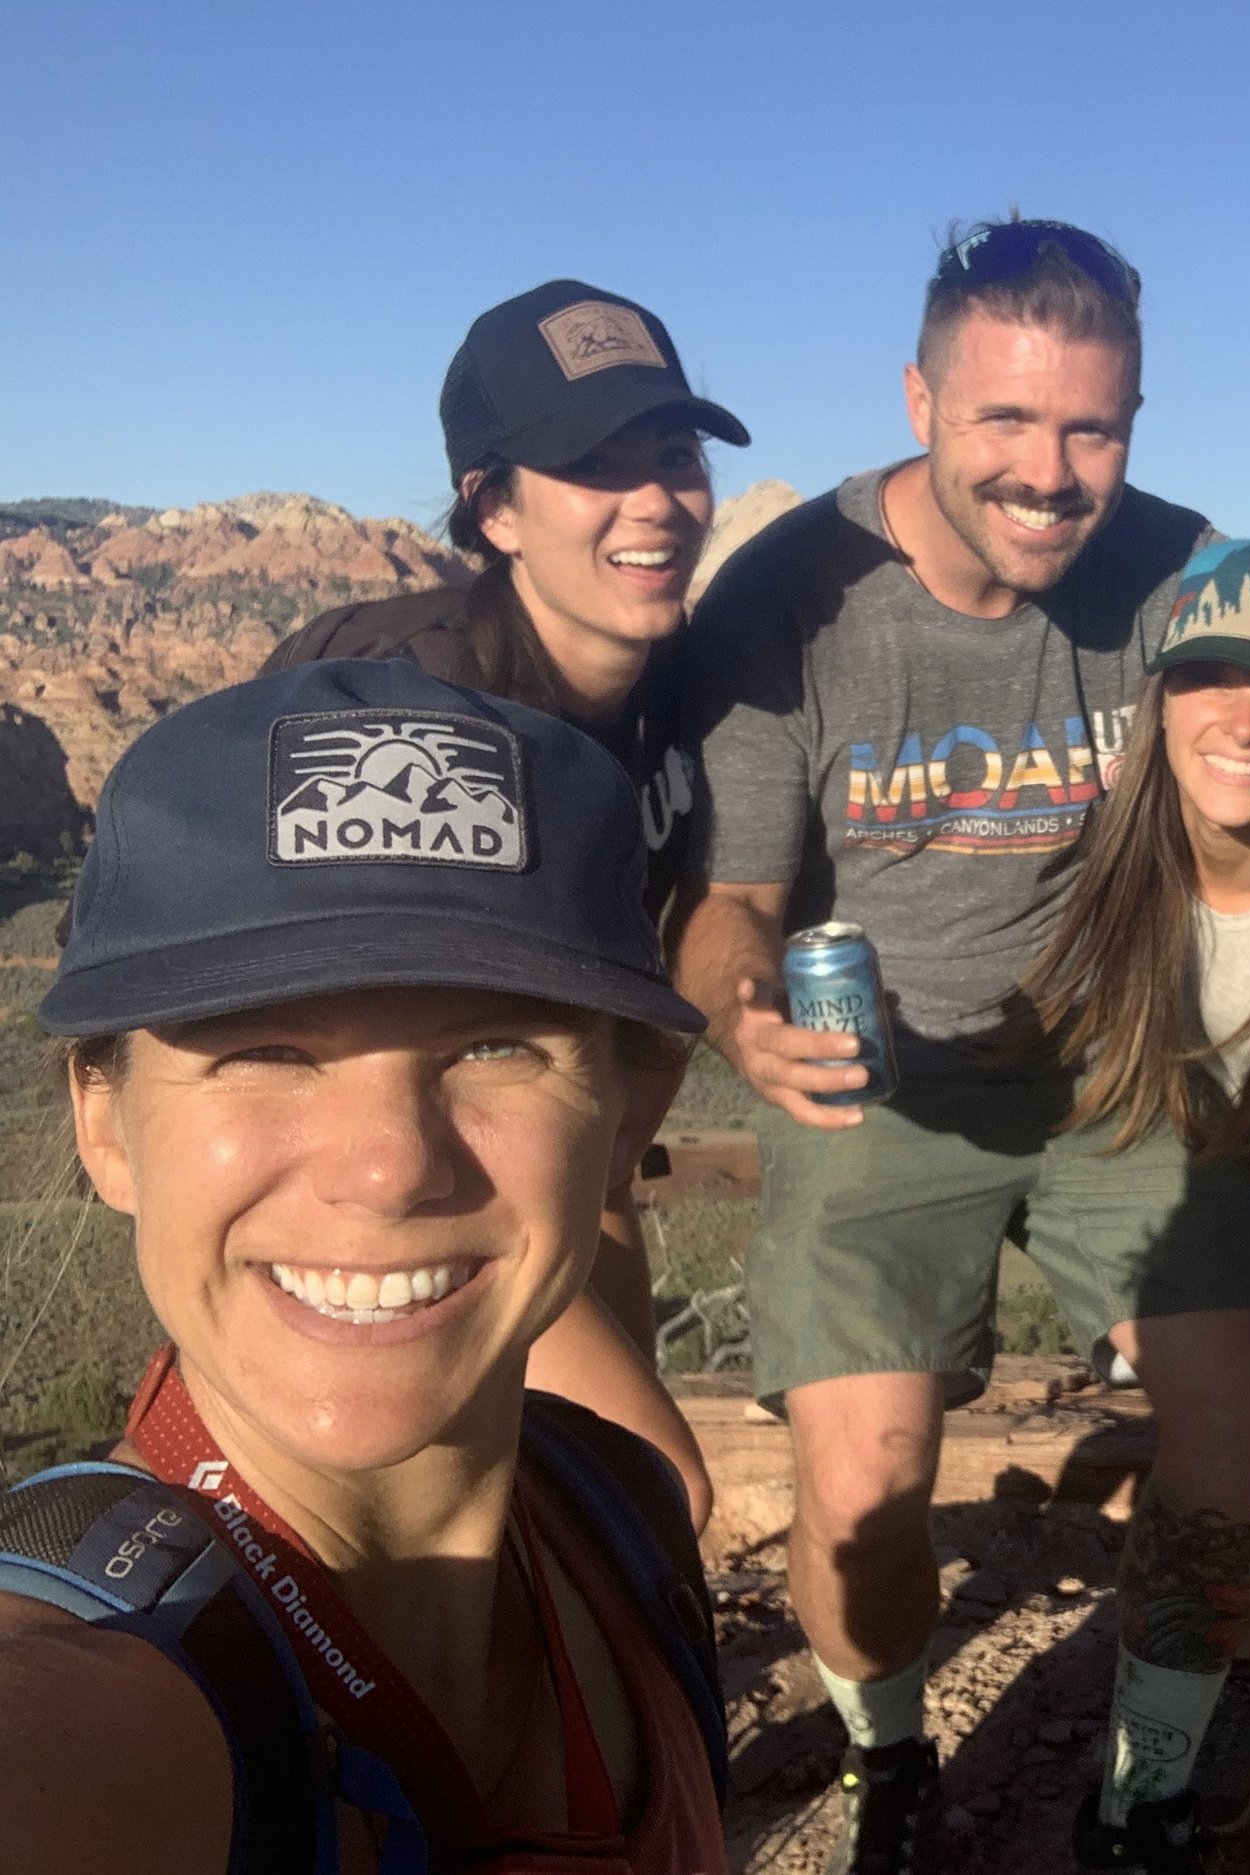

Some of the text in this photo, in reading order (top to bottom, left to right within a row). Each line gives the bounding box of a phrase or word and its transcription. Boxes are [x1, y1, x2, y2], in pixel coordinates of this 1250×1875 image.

[847, 713, 1100, 823] MOAB
[294, 818, 503, 857] NOMAD
[845, 828, 919, 843] ARCHES
[940, 816, 1060, 836] CANYONLANDS
[799, 994, 864, 1018] MIND
[214, 1495, 377, 1700] Black Diamond
